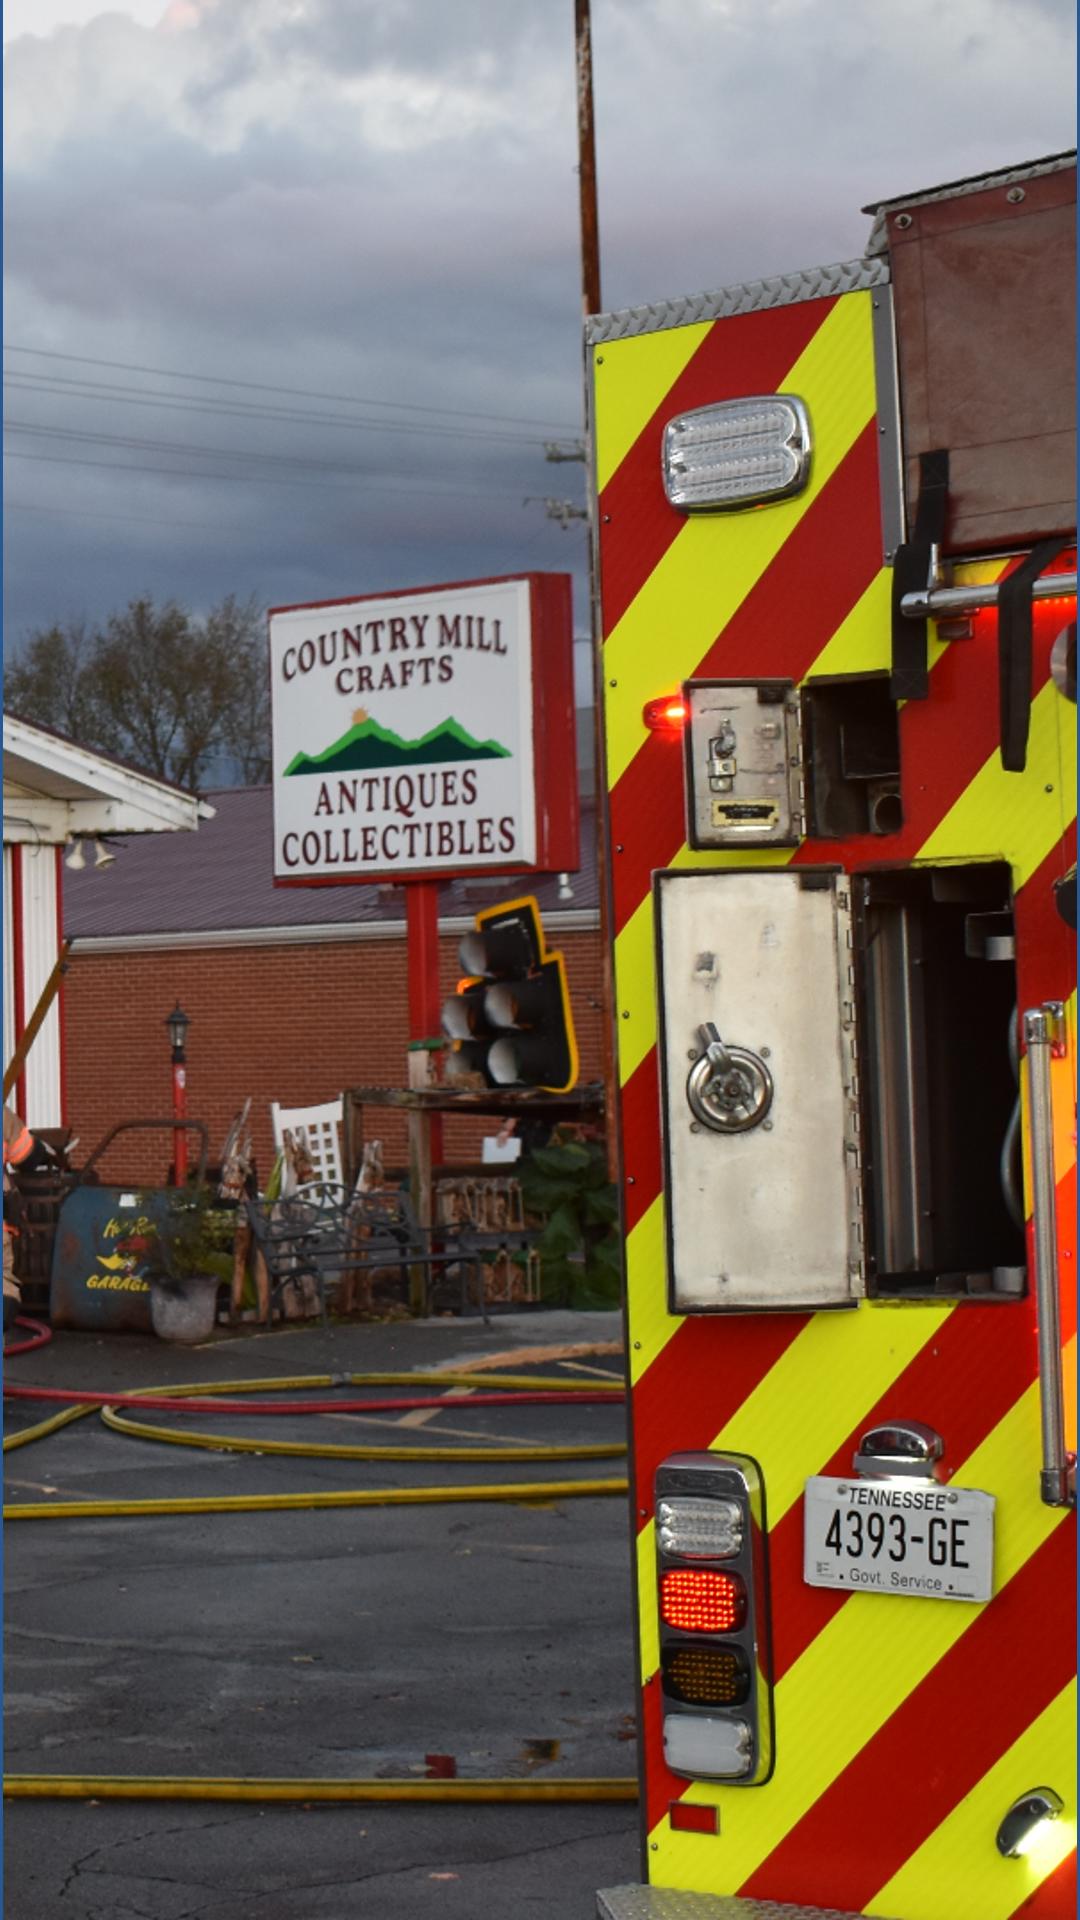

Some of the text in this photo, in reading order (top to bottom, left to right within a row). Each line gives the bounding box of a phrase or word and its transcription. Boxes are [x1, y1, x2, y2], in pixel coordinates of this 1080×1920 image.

[282, 614, 507, 681] COUNTRY MILL
[335, 654, 453, 694] CRAFTS
[314, 768, 477, 817] ANTIQUES
[282, 816, 515, 867] COLLECTIBLES
[849, 1487, 946, 1511] TENNESSEE
[825, 1509, 969, 1568] 4393-GE
[850, 1568, 884, 1585] Govt.
[890, 1571, 943, 1591] Service
